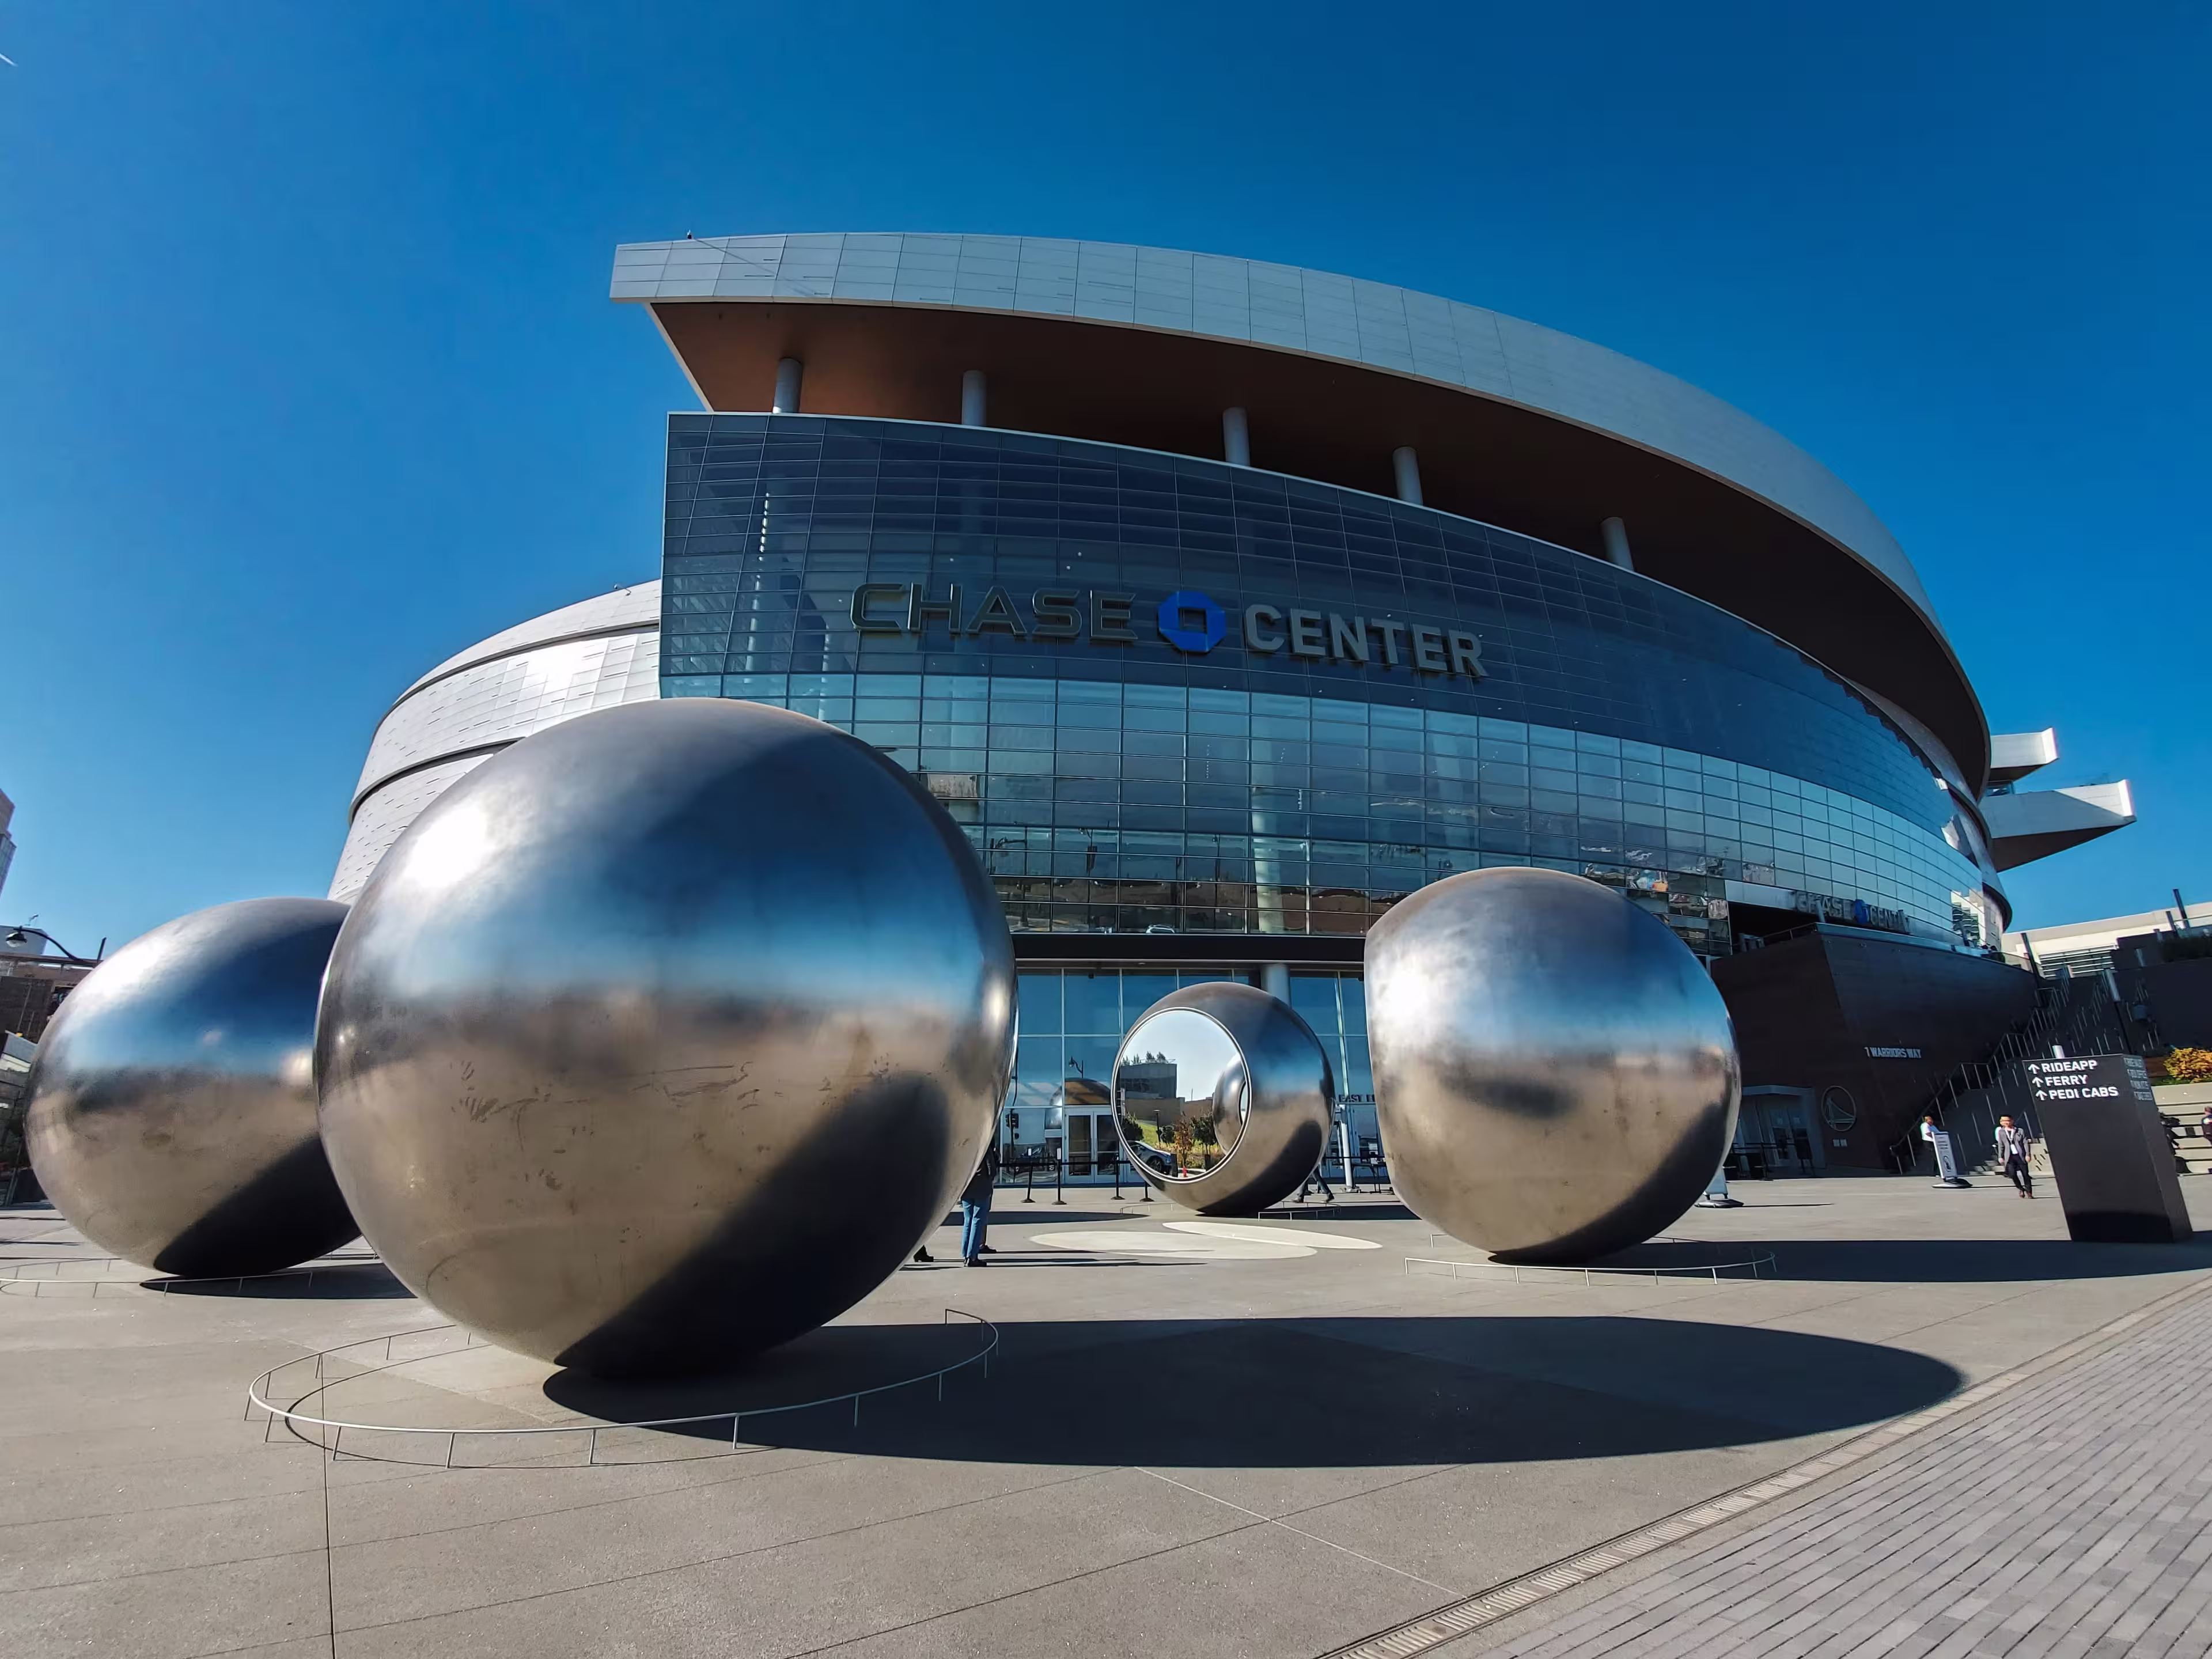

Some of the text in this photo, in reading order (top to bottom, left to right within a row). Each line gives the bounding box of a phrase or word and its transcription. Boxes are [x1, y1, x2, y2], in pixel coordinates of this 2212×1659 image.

[850, 582, 1488, 678] CHASE CENTER
[1870, 1047, 1907, 1058] WARRIORS
[1906, 1048, 1922, 1058] WAY
[2041, 1060, 2097, 1073] RIDEAPP
[2045, 1074, 2088, 1086] FERRY
[2048, 1086, 2119, 1100] PEDI CABS
